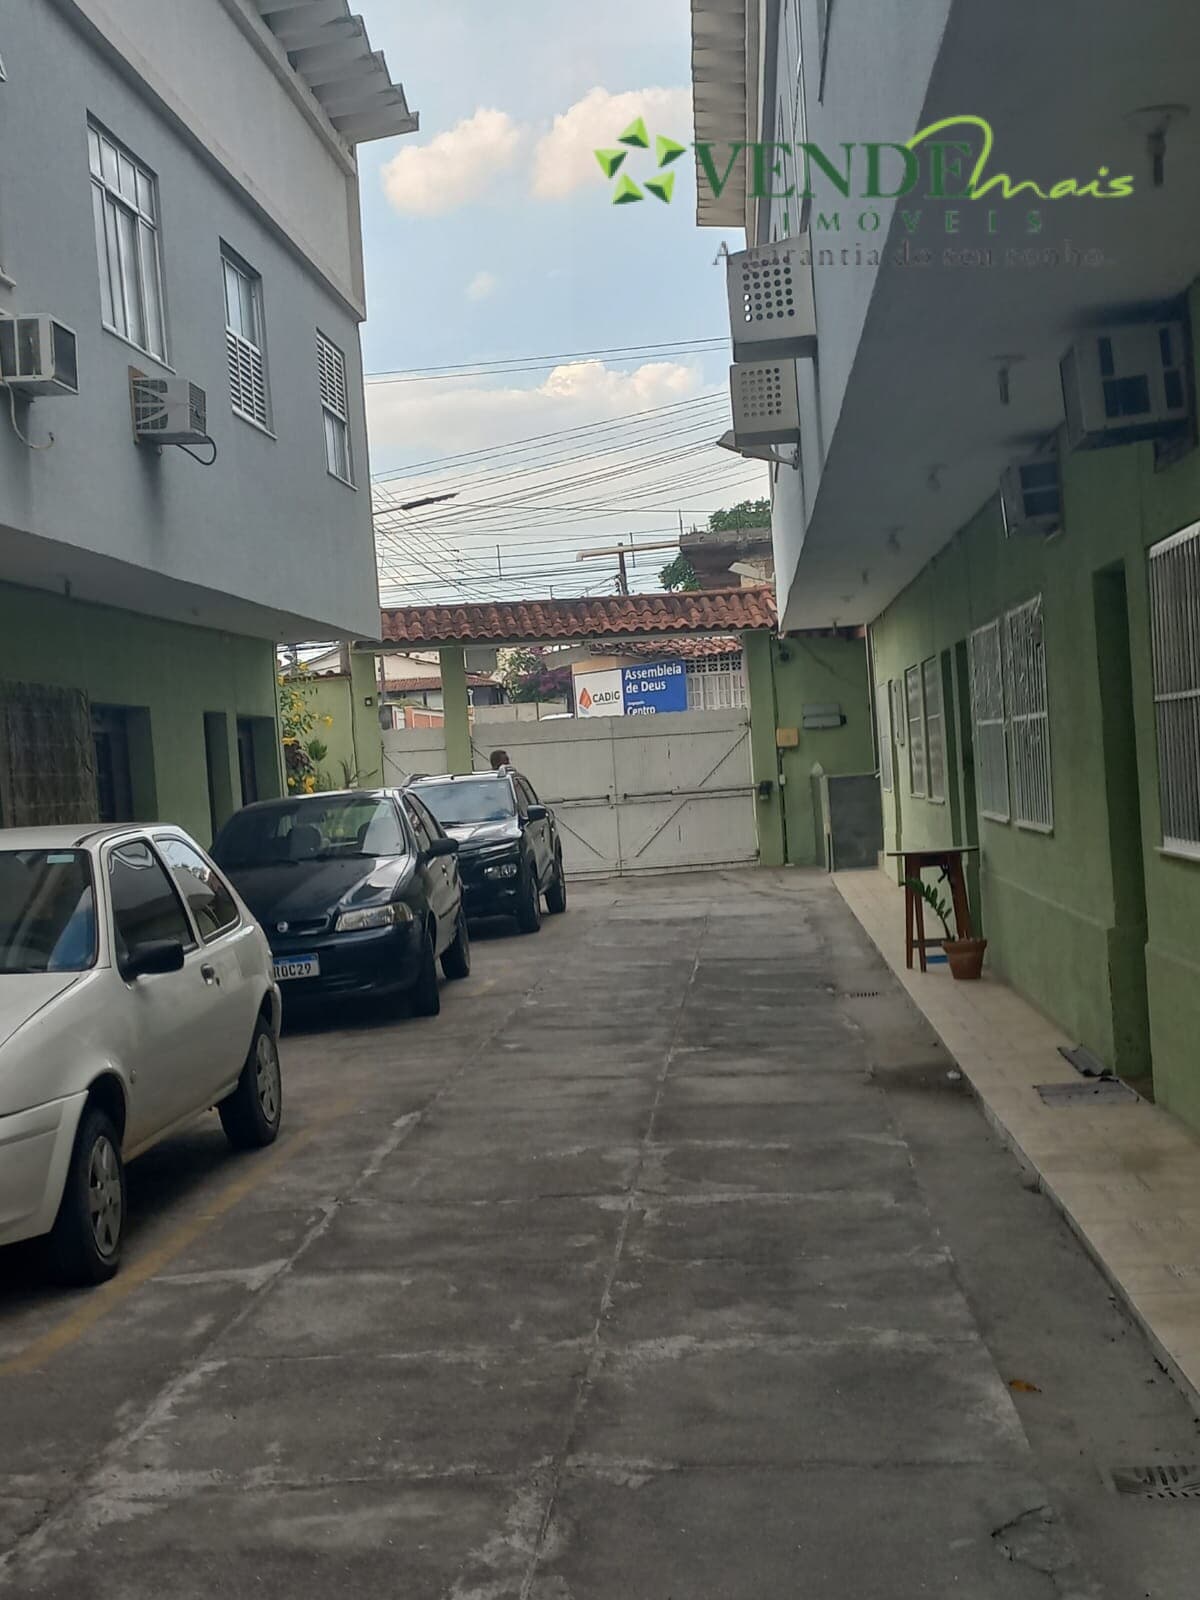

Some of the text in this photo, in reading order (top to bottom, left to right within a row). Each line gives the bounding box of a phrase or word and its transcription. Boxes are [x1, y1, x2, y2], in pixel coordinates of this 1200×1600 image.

[625, 664, 682, 681] Assembleia
[627, 681, 666, 694] de Deus
[593, 690, 620, 703] CADIG
[627, 706, 656, 716] Centro
